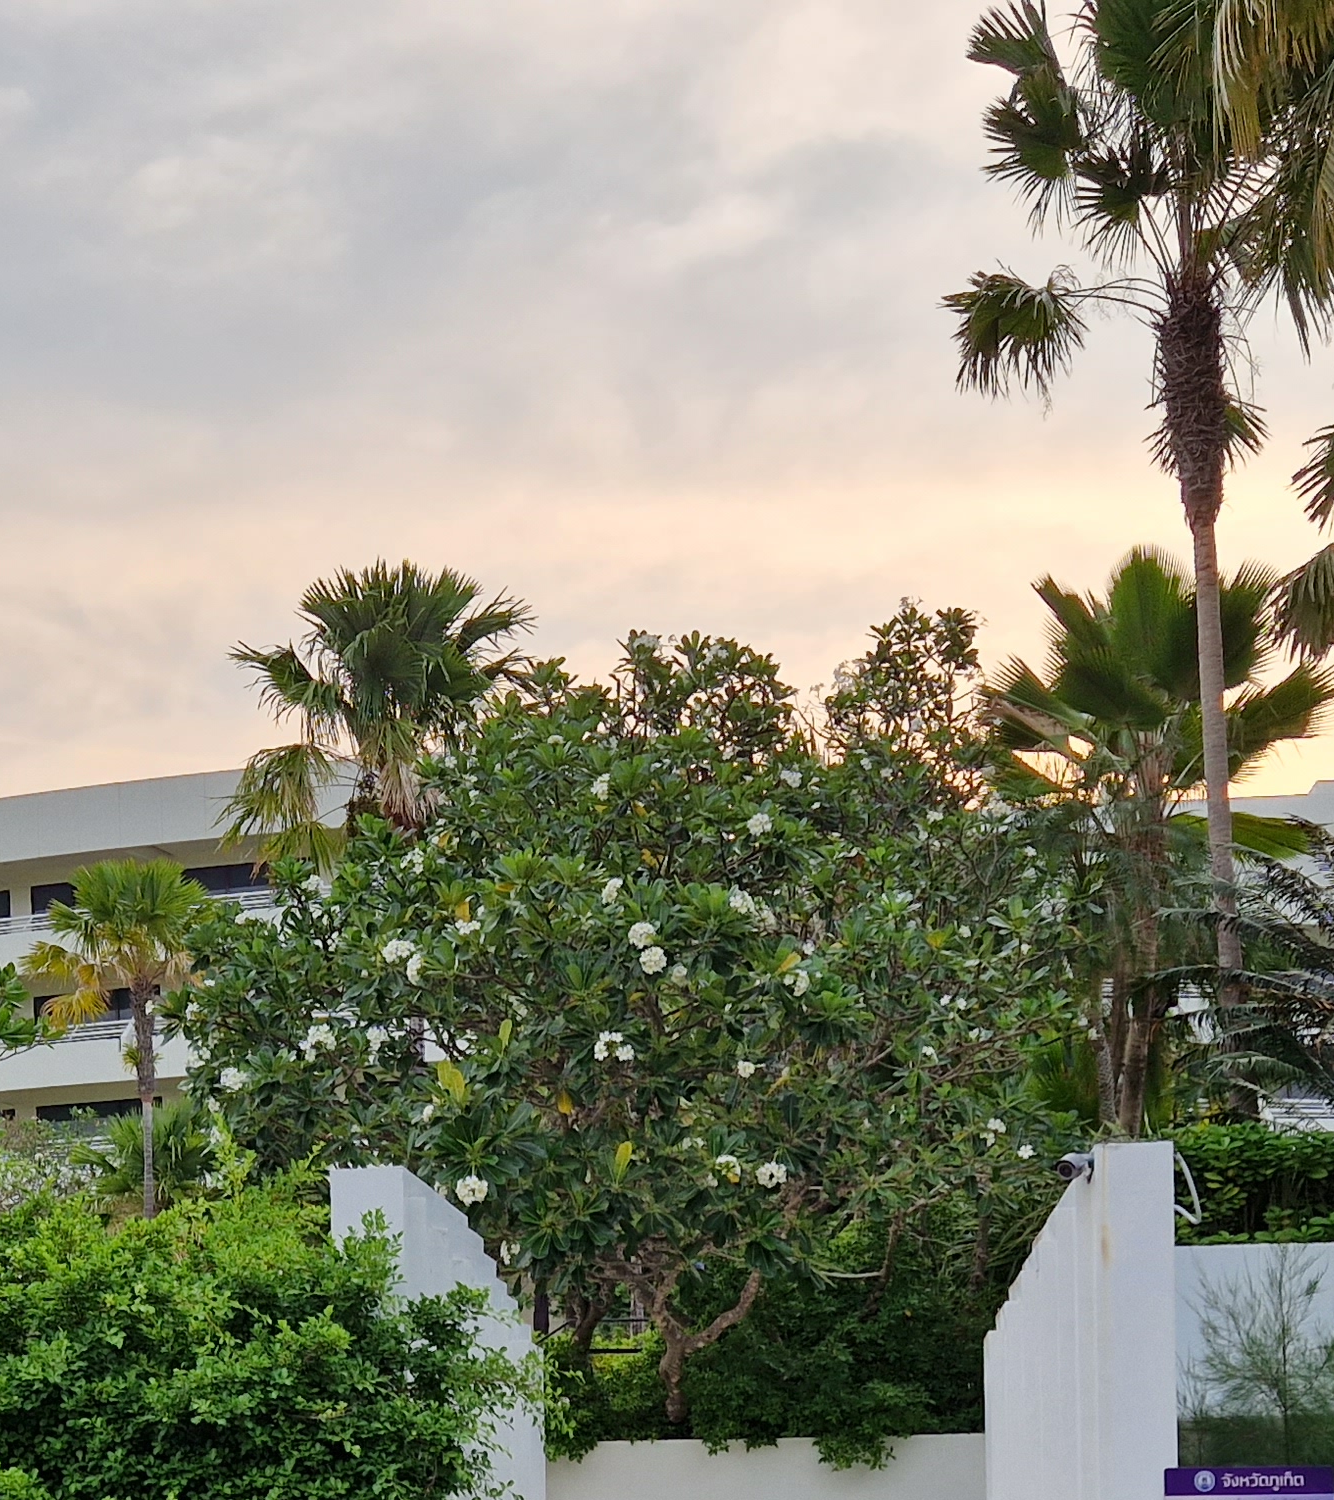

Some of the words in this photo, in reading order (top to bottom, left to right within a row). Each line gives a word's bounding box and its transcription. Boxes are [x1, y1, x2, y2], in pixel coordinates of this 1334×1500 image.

[1221, 1471, 1304, 1491] จังหวัดภูเก็ต
